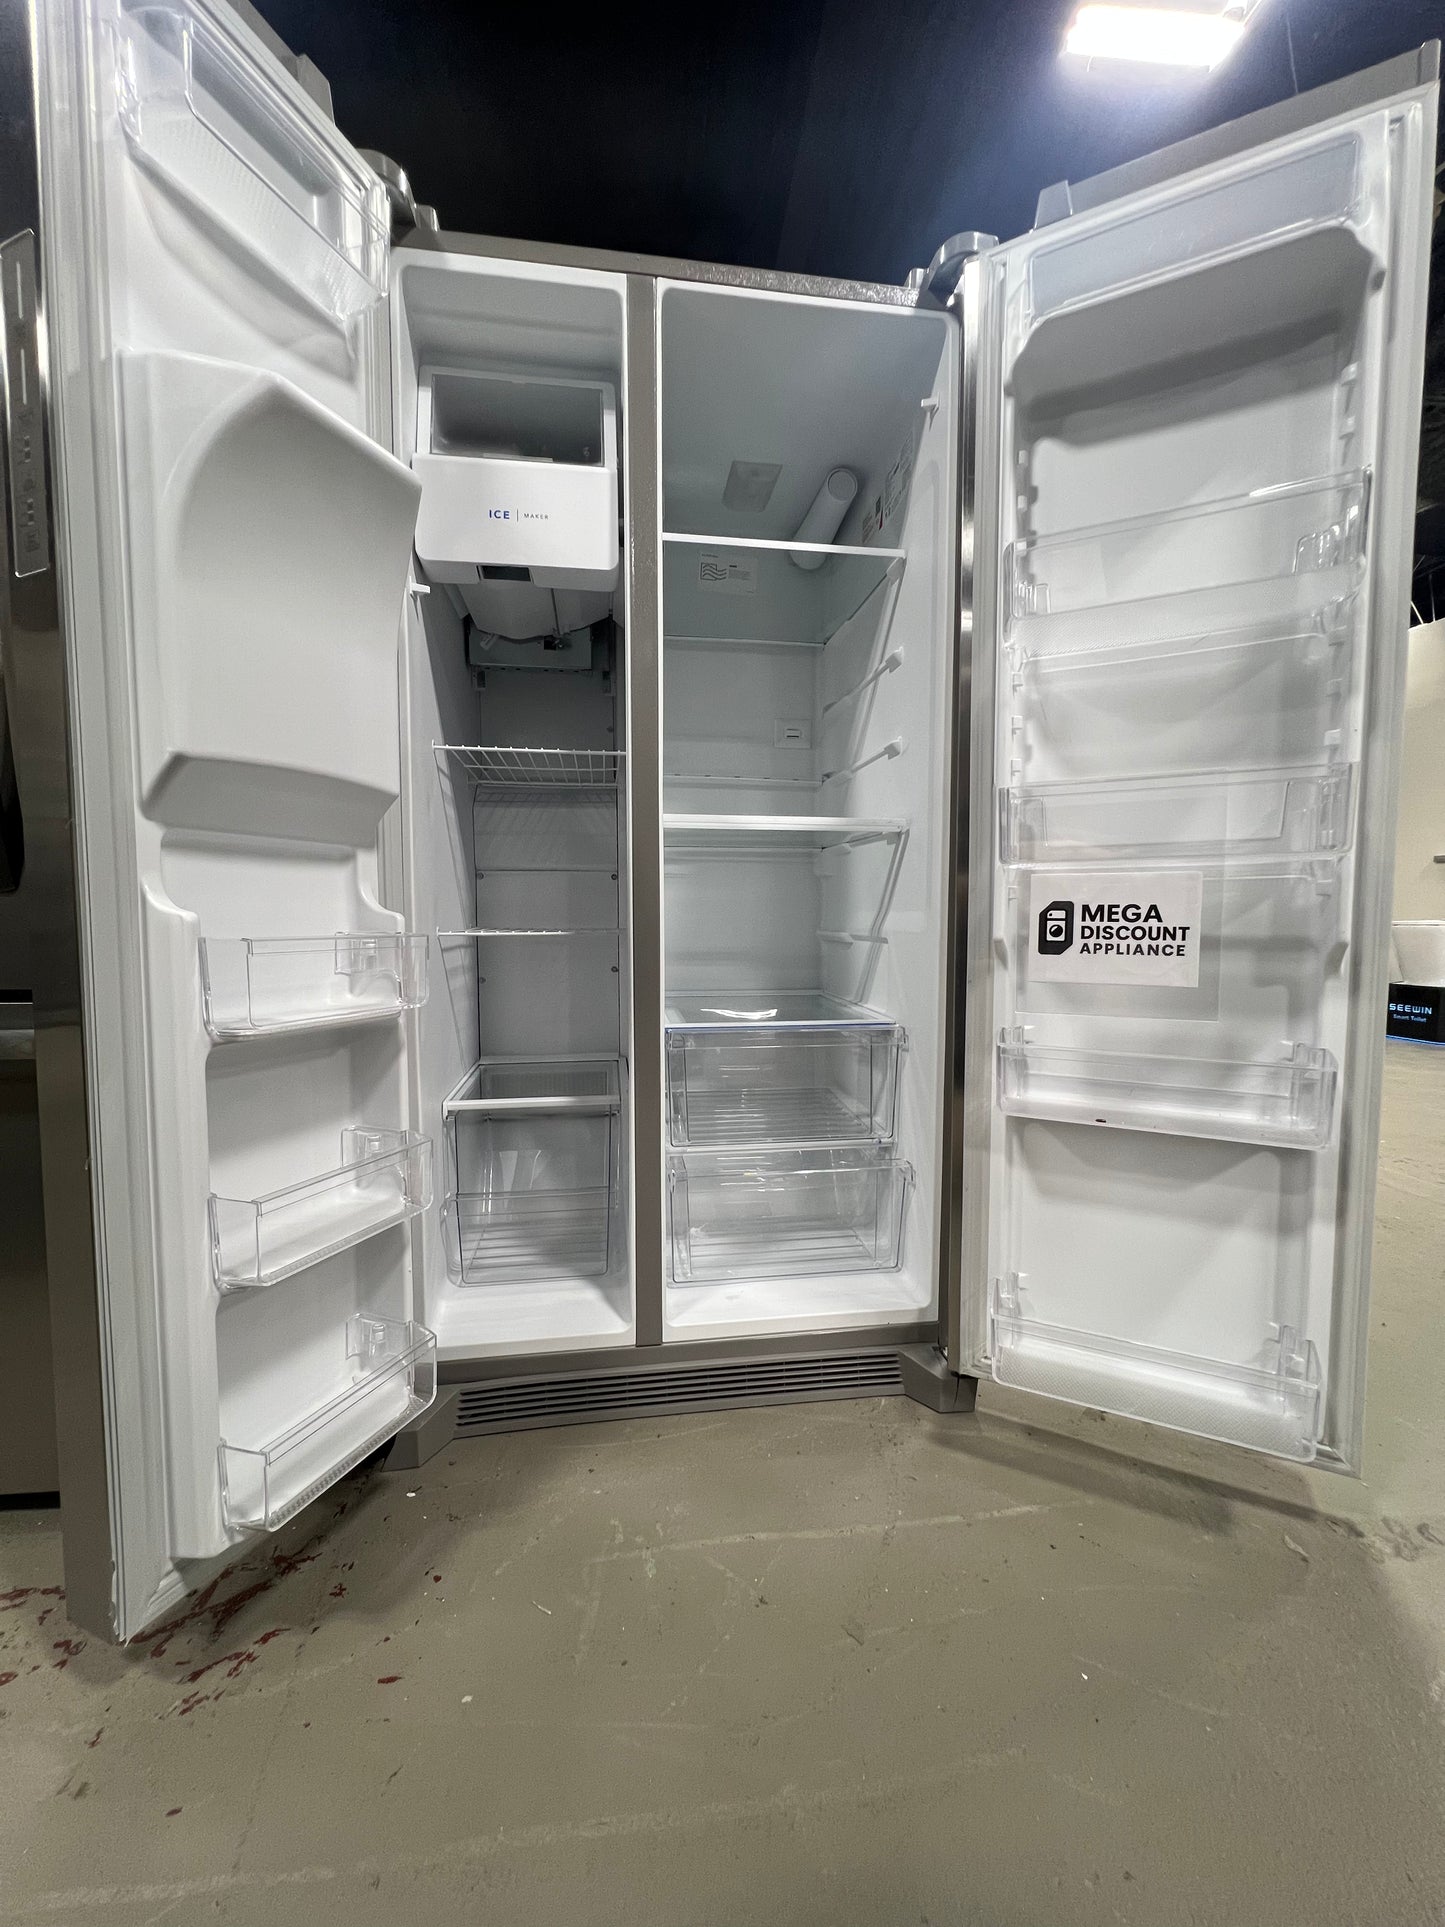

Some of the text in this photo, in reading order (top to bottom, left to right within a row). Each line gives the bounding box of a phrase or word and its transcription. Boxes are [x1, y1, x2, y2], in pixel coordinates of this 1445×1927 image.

[489, 509, 510, 520] ICE
[1081, 903, 1163, 923] MEGA
[1080, 925, 1190, 942] DISCOUNT
[1079, 943, 1186, 957] APPLIANCE
[1389, 1003, 1433, 1015] SEEWIN
